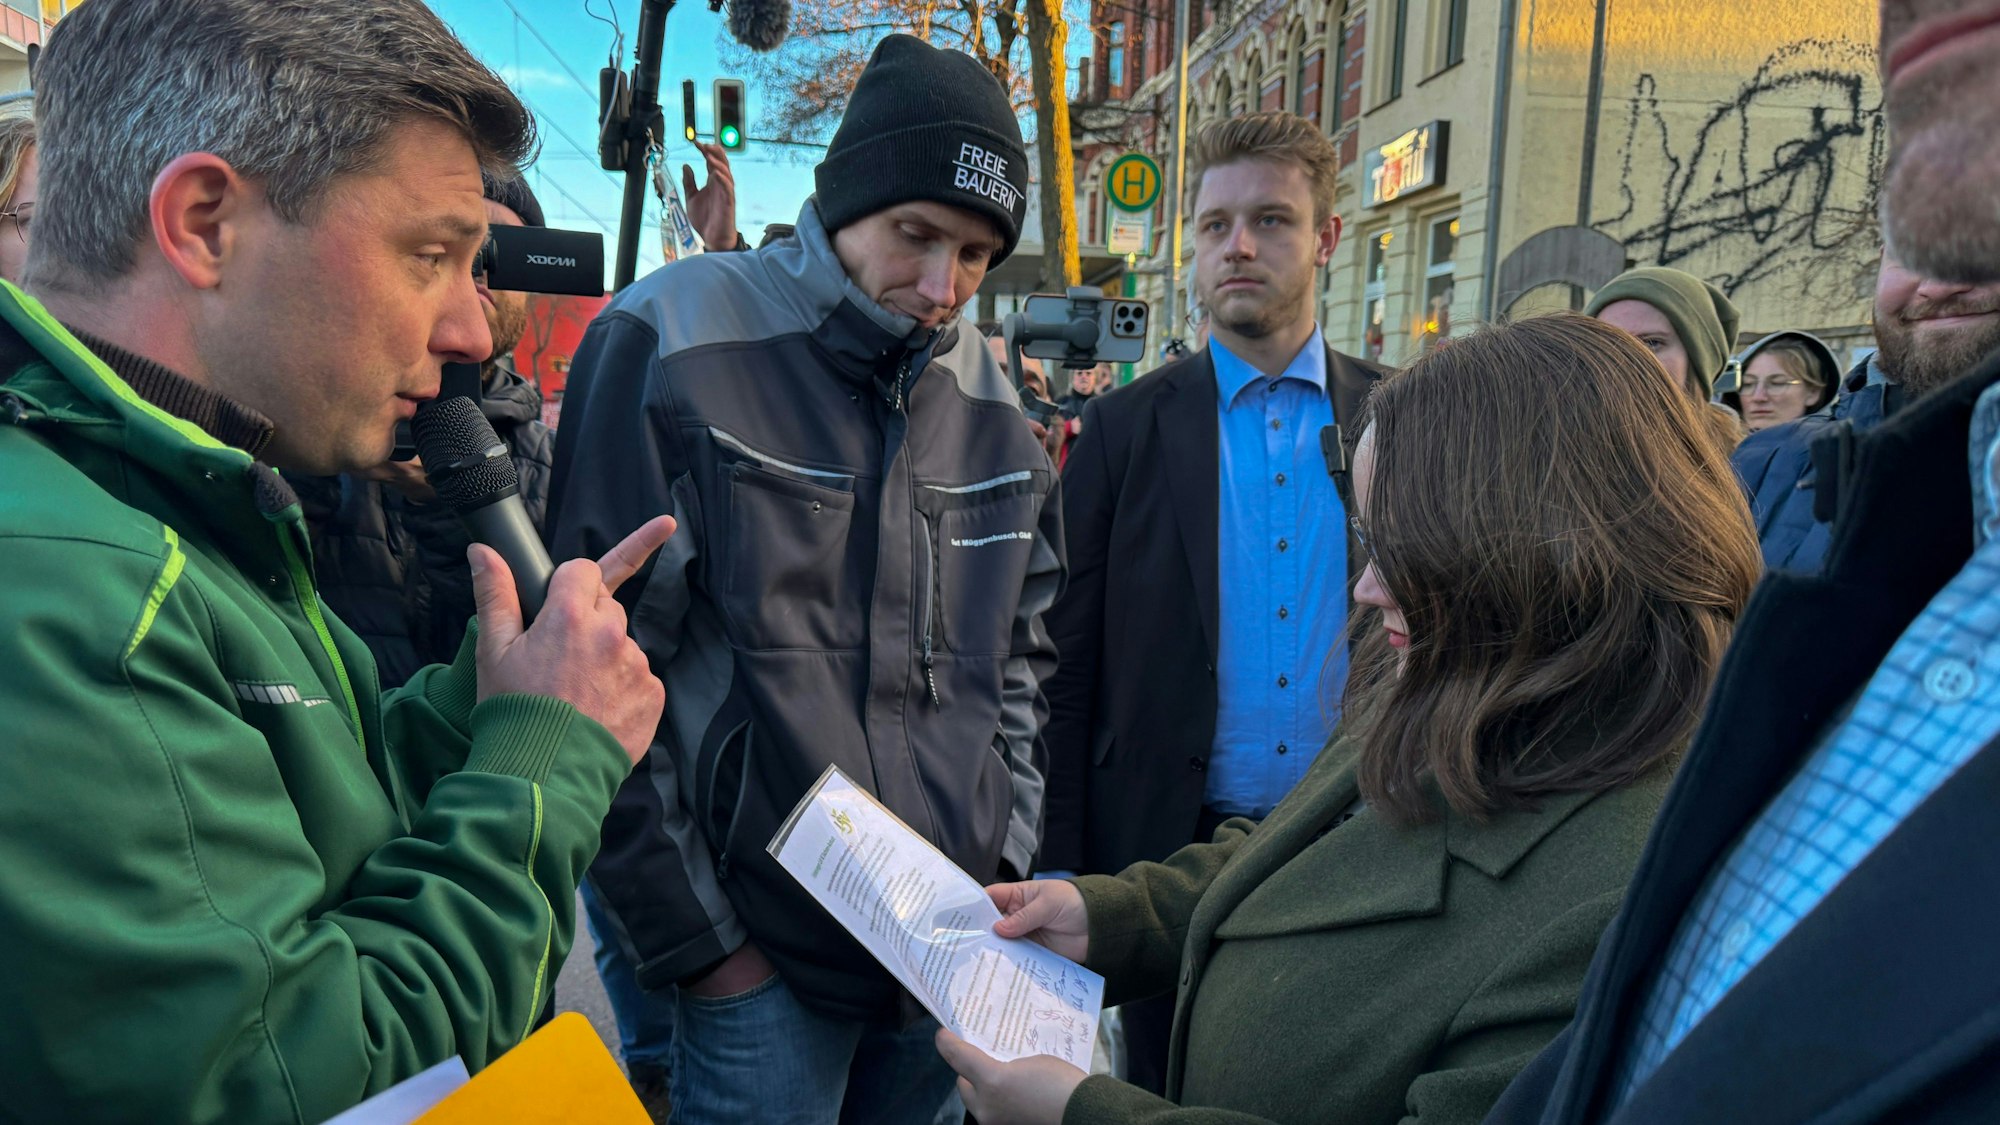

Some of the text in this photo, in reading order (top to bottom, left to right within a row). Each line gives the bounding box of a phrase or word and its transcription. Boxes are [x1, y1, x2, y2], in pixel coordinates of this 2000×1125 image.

[959, 142, 1009, 178] FREIE
[953, 166, 1017, 213] BAUERN
[1122, 166, 1146, 199] H
[526, 254, 576, 268] XDCAM
